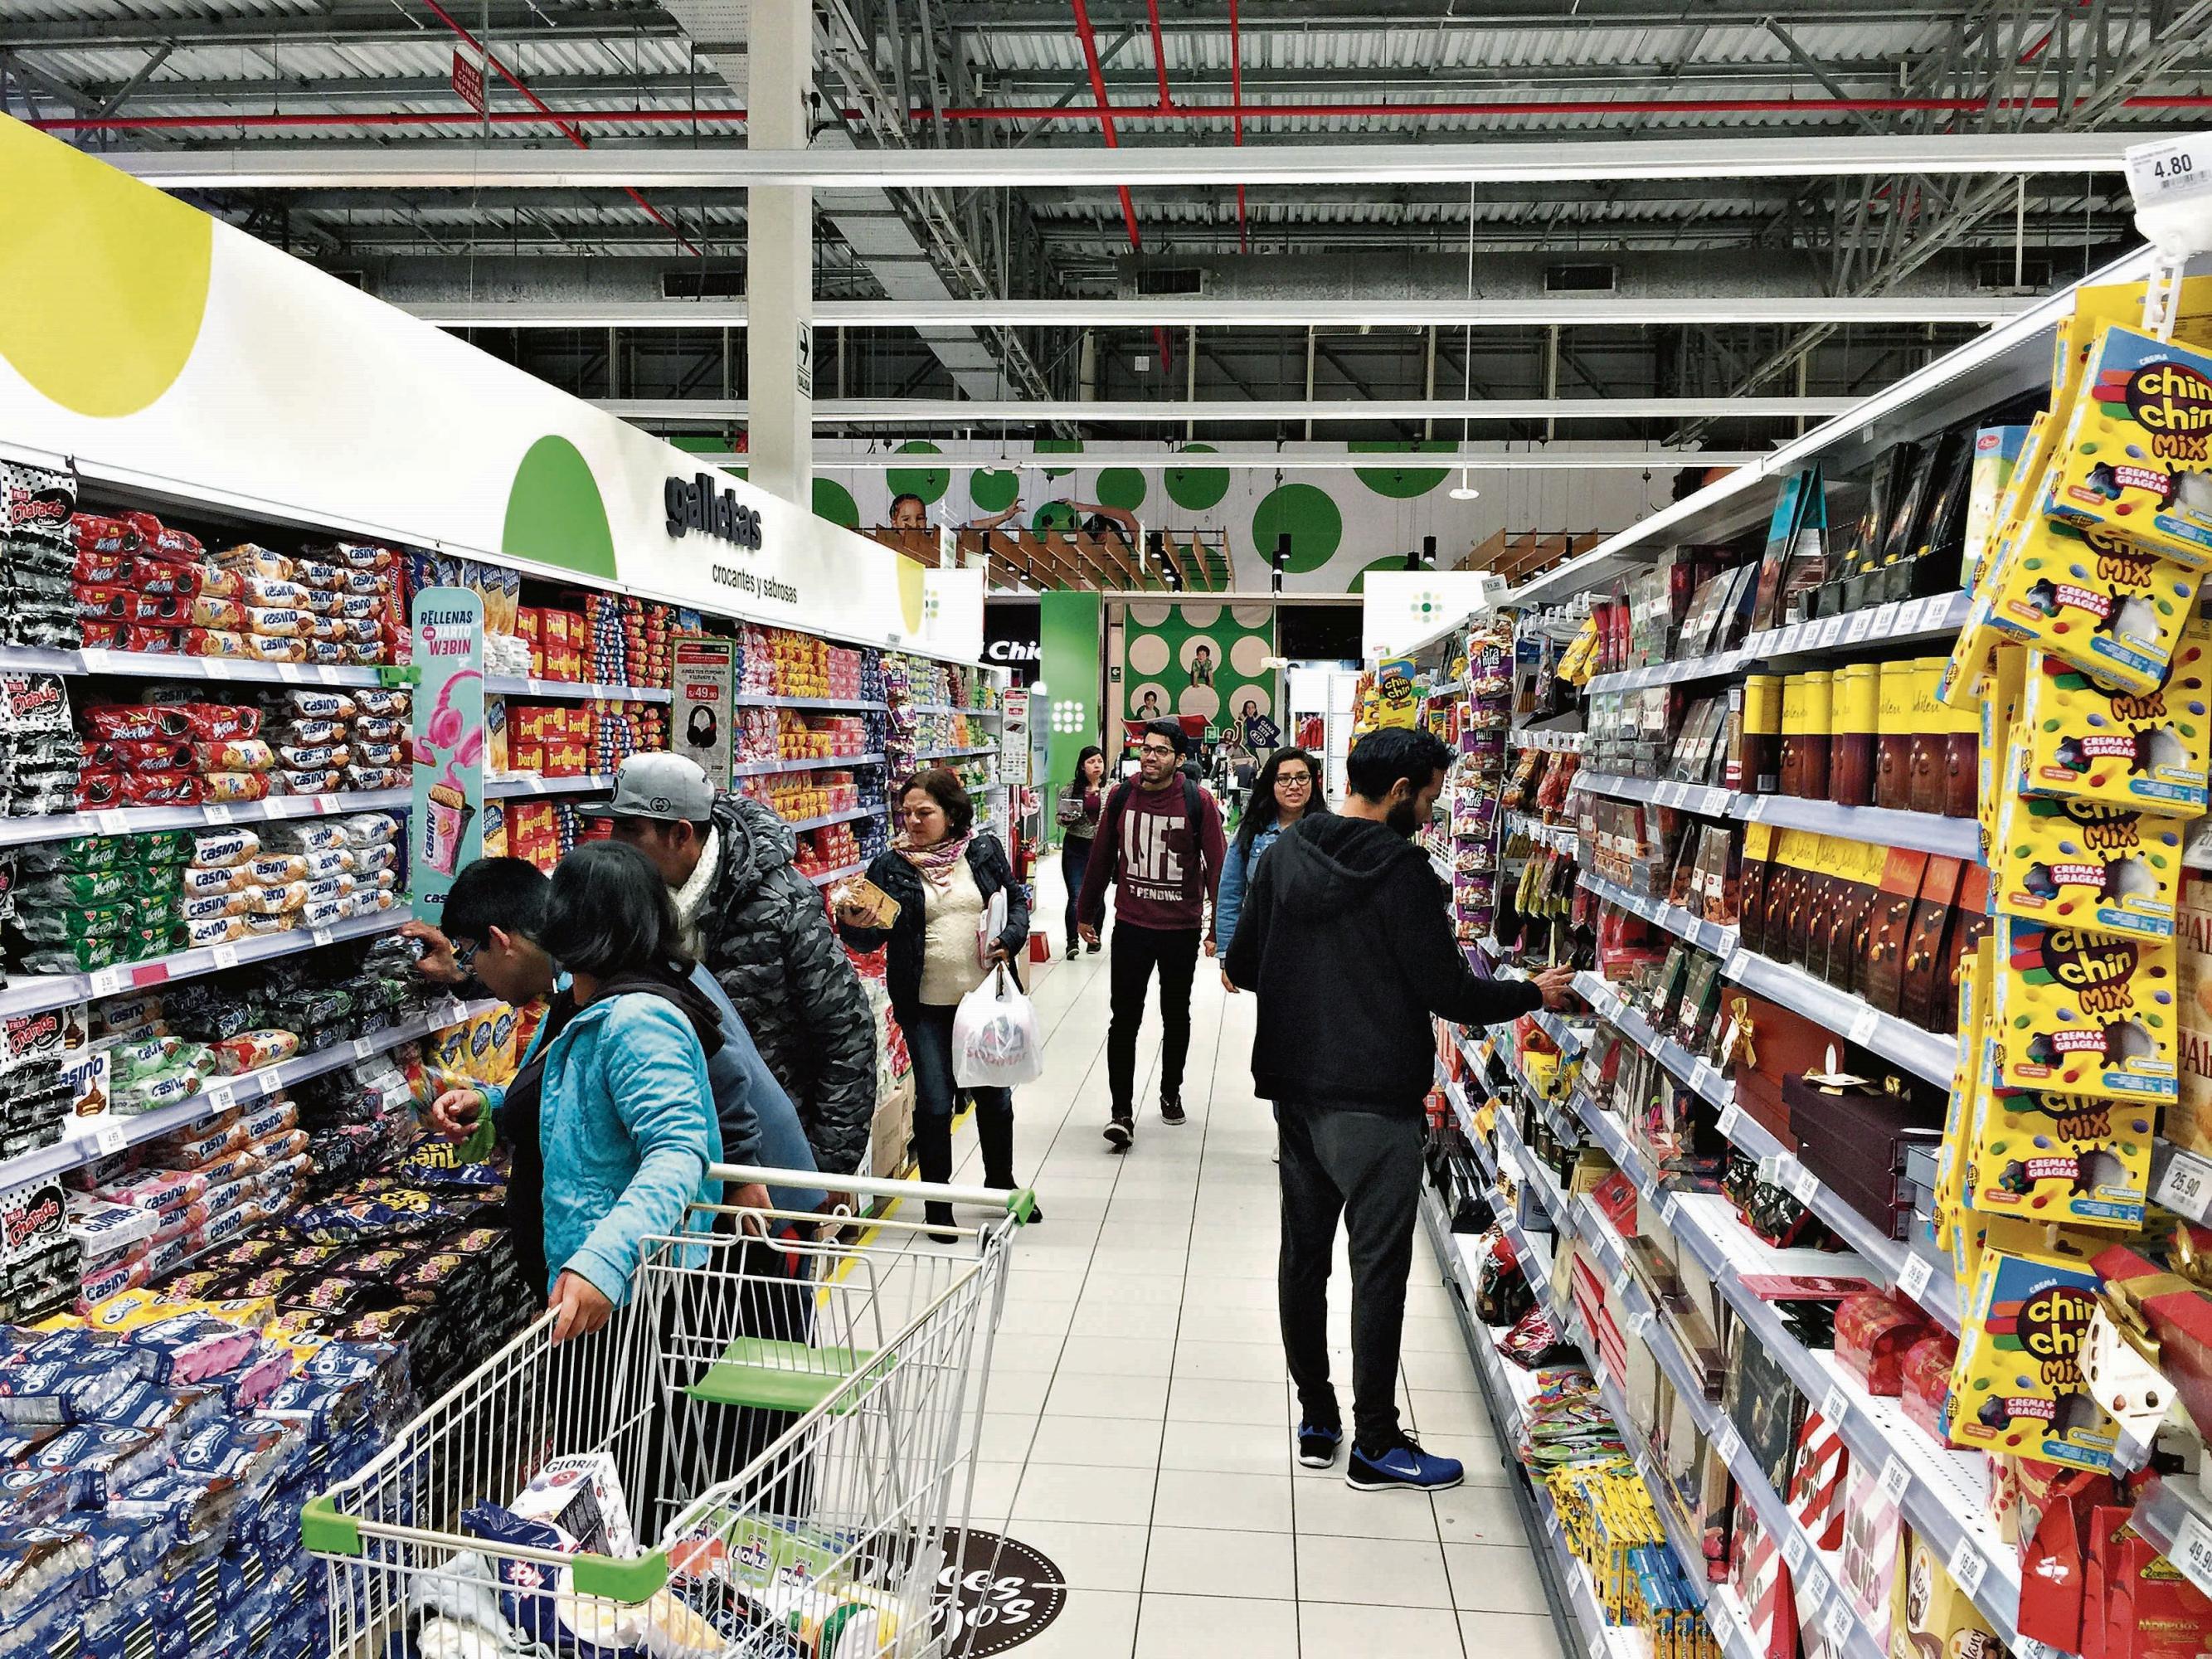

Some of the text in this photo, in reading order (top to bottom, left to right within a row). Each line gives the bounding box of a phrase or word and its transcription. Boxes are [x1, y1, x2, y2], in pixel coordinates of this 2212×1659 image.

[461, 61, 480, 84] LINEA
[458, 70, 483, 100] CONTRA
[2153, 153, 2193, 178] 4.80
[2115, 474, 2169, 494] GRAGEAS
[12, 499, 66, 524] Charada
[664, 473, 762, 551] galletas
[349, 547, 377, 559] casino
[712, 564, 798, 604] crocantes y sabrosas
[2057, 595, 2110, 617] GRAGEAS
[1481, 645, 1500, 658] Gra
[1482, 654, 1500, 666] nuts
[1384, 678, 1408, 689] chin
[1387, 685, 1410, 698] chin
[303, 698, 339, 712] casino
[1252, 732, 1266, 746] KIA
[1257, 725, 1270, 738] ESTE
[1260, 720, 1276, 736] GANA
[2083, 746, 2137, 757] GRAGEAS
[293, 769, 327, 786] casino
[201, 839, 244, 863] casino
[1124, 809, 1185, 881] LIFE
[256, 859, 288, 875] asino
[2054, 874, 2107, 885] GRAGEAS
[189, 894, 229, 916] casino
[1136, 887, 1184, 902] PENDING
[2057, 951, 2132, 985] chin
[10, 1016, 57, 1055] Charada
[2055, 1039, 2107, 1051] GRAGEAS
[60, 1057, 104, 1086] asino
[250, 1112, 283, 1137] casino
[2028, 1168, 2078, 1178] GRAGEAS
[2170, 1170, 2202, 1198] 25.90
[144, 1185, 187, 1209] casino
[9, 1198, 60, 1248] Charada
[210, 1210, 242, 1238] casino
[85, 1268, 130, 1301] casino
[2029, 1277, 2059, 1294] CREMA
[2029, 1323, 2086, 1355] chi
[2006, 1407, 2056, 1420] GRAGEAS
[37, 1430, 87, 1467] OREO
[181, 1423, 229, 1466] OREO
[544, 1459, 600, 1474] GLORIA
[1959, 1552, 1978, 1579] 16.00
